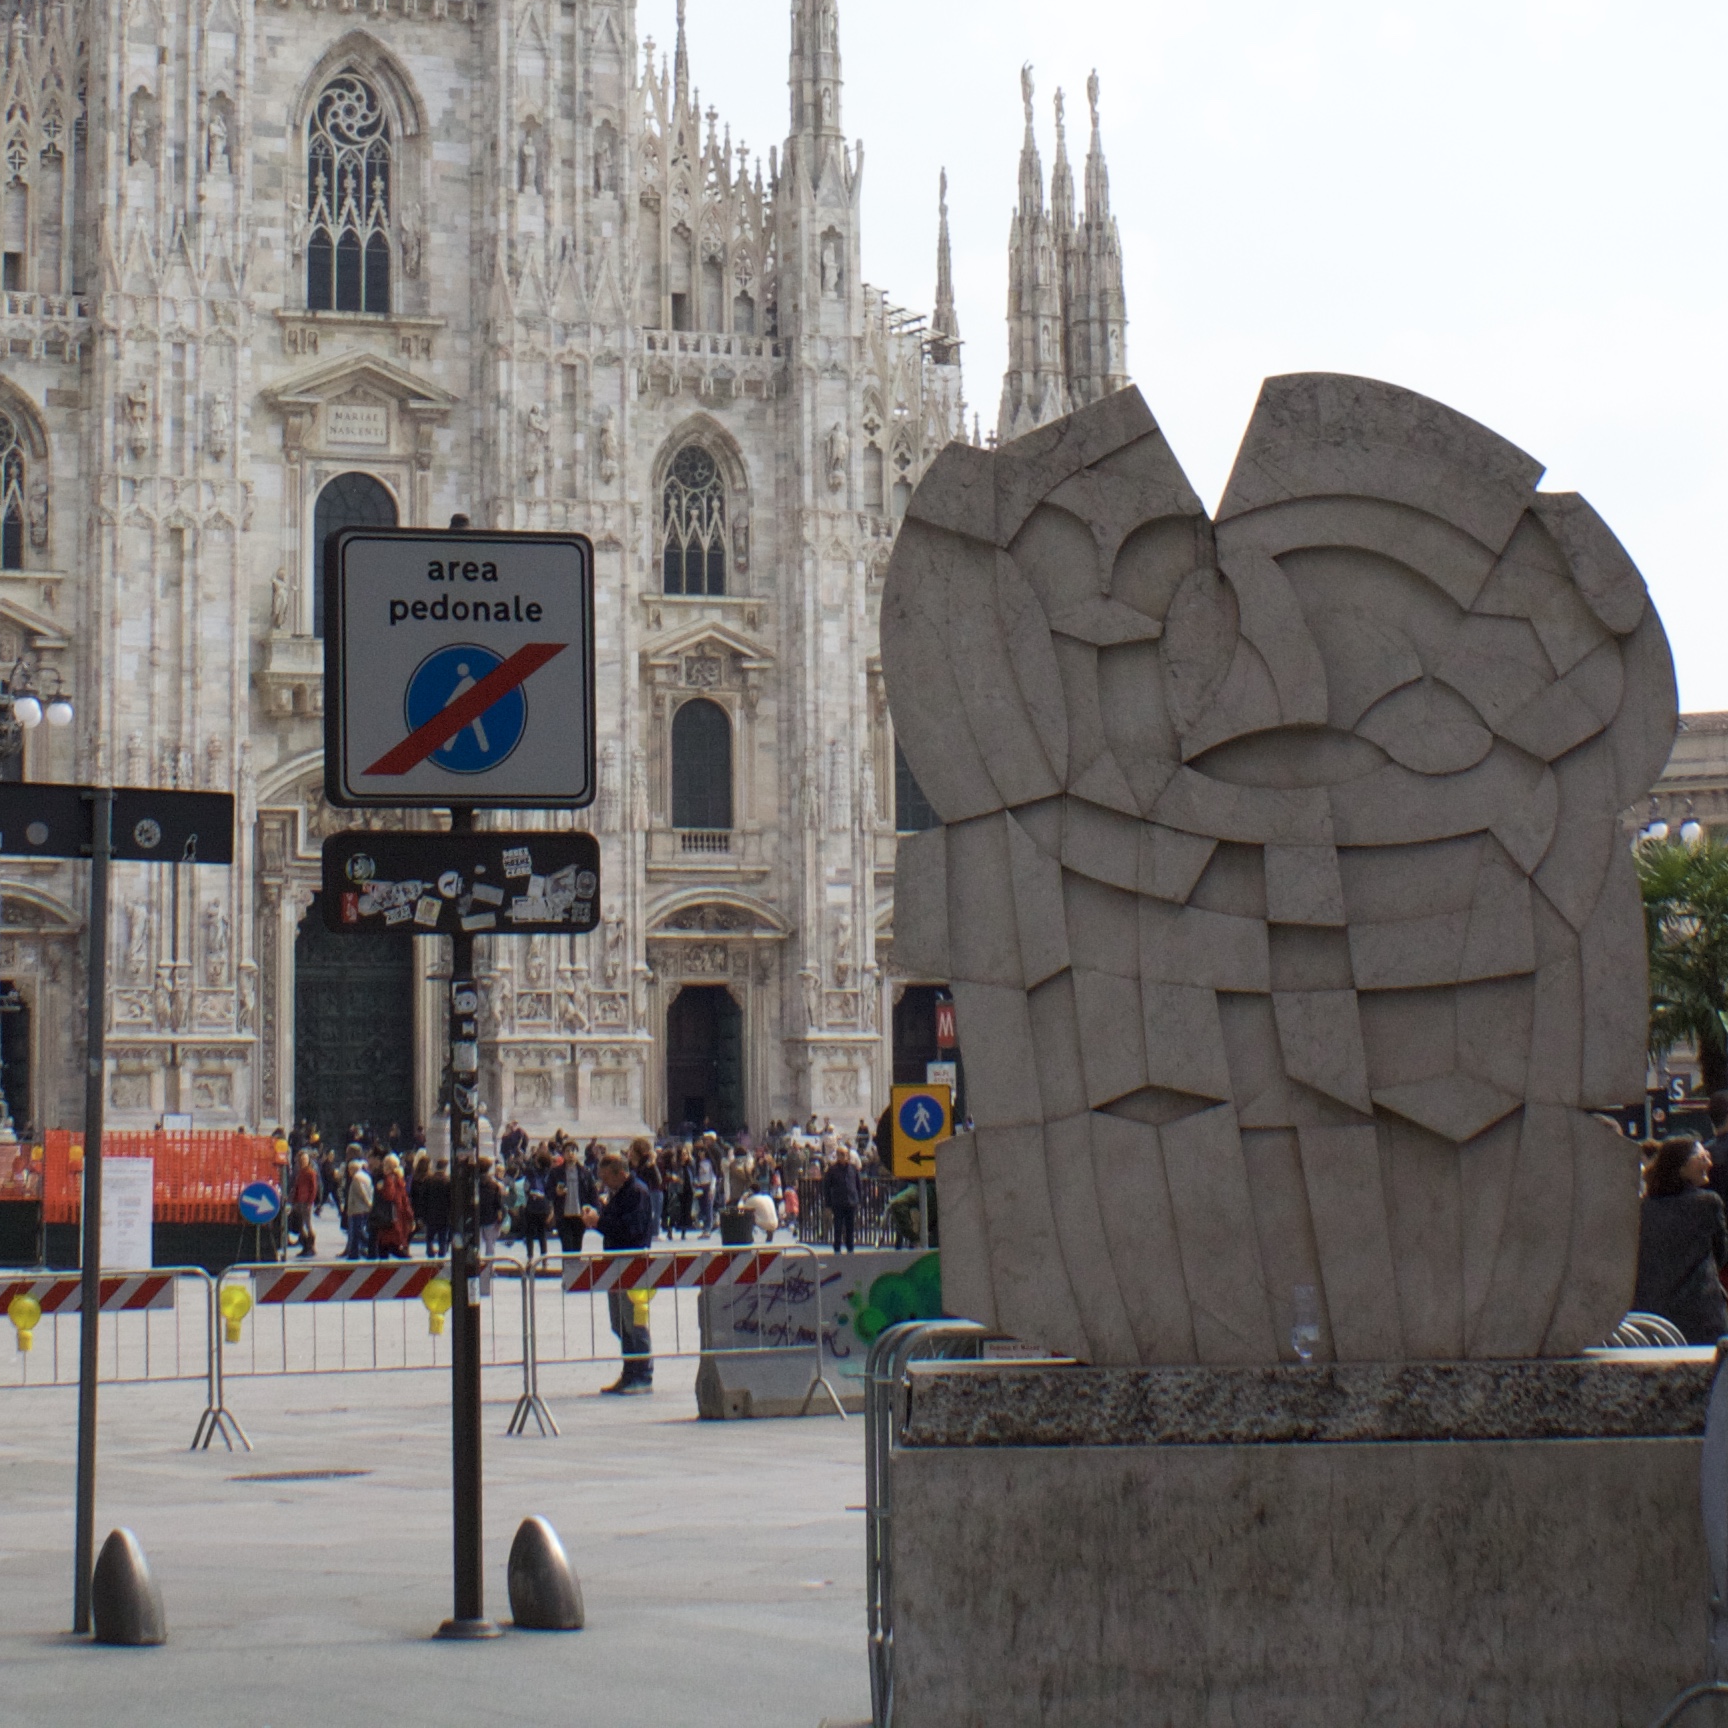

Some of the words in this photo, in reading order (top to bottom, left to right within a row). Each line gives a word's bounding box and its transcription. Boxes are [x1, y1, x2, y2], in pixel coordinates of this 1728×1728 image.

[427, 559, 499, 583] area
[389, 593, 544, 626] pedonale
[938, 1011, 954, 1038] M
